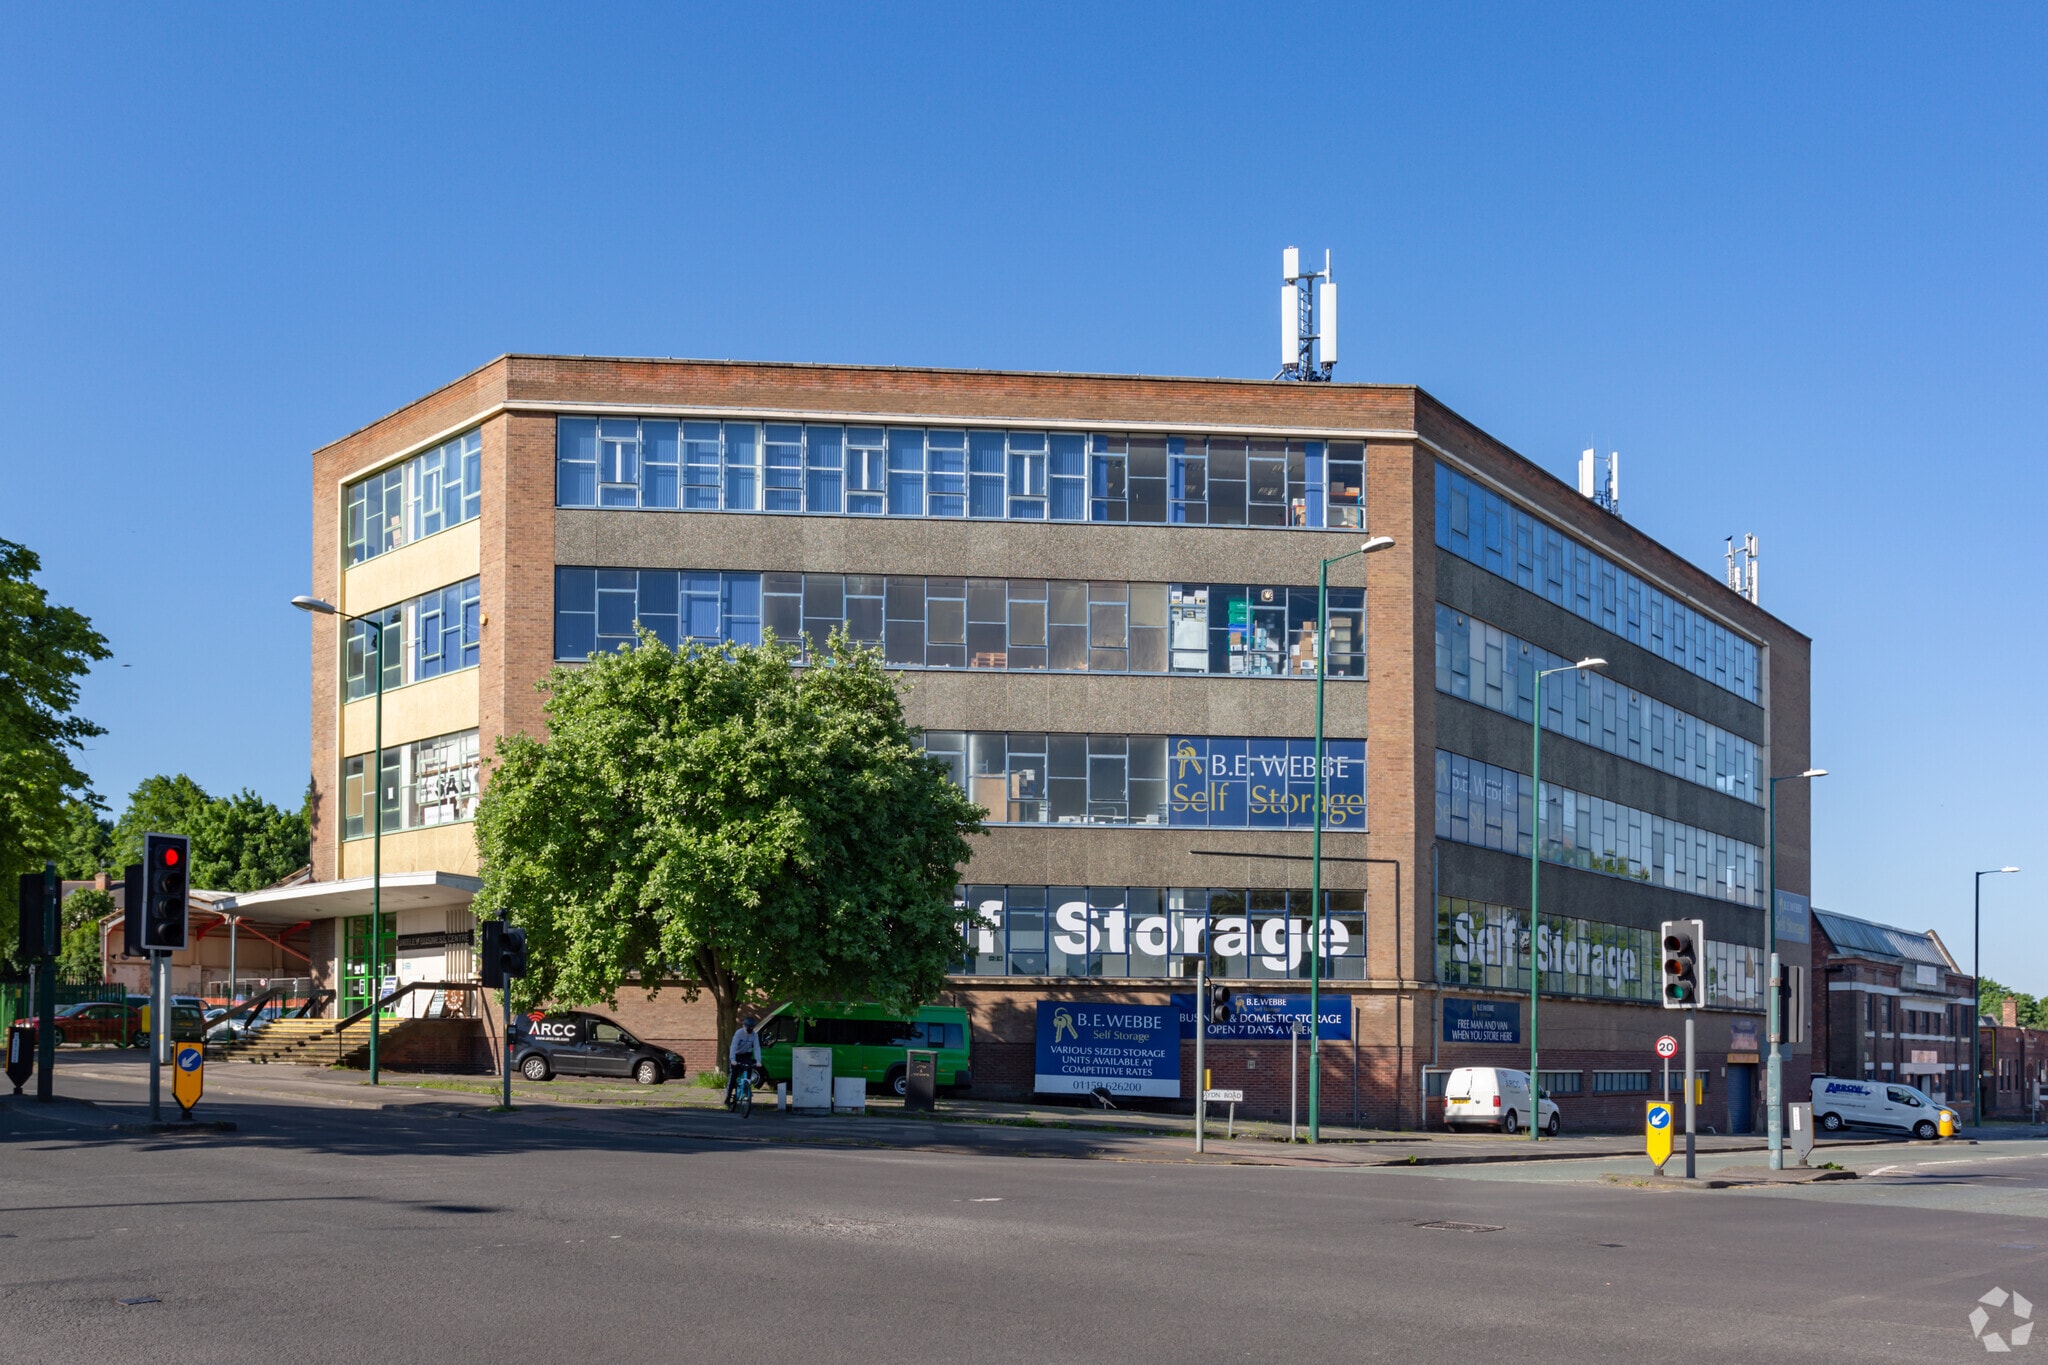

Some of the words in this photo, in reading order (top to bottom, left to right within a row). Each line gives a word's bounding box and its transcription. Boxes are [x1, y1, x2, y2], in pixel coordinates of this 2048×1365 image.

[1259, 755, 1349, 778] WEBBE
[1173, 782, 1229, 812] Self
[1251, 785, 1364, 825] Storage
[1054, 901, 1351, 972] Storage
[1454, 912, 1518, 967] Self
[1537, 925, 1636, 990] Storage
[1229, 1013, 1237, 1023] &
[1240, 1013, 1294, 1024] DOMESTIC
[528, 1021, 577, 1037] ARCC
[1207, 1025, 1236, 1034] OPEN
[1239, 1025, 1245, 1034] 7
[1247, 1025, 1274, 1034] DAYS
[1276, 1025, 1284, 1034] A
[1457, 1019, 1470, 1029] FREE
[1470, 1020, 1483, 1030] MAN
[1484, 1020, 1496, 1031] AND
[1497, 1021, 1508, 1031] VAN
[1093, 1030, 1111, 1040] Self
[1113, 1030, 1150, 1043] Storage
[1451, 1030, 1470, 1040] WHEN
[1470, 1031, 1482, 1041] YOU
[1483, 1031, 1499, 1041] STORE
[1500, 1032, 1513, 1041] HERE
[1050, 1045, 1093, 1055] VARIOUS
[1094, 1047, 1121, 1056] SIZED
[1123, 1048, 1166, 1058] STORAGE
[1659, 1043, 1674, 1052] 20
[1062, 1056, 1090, 1065] UNITS
[1092, 1057, 1140, 1067] AVAILABLE
[1141, 1059, 1153, 1067] AT
[1061, 1065, 1124, 1076] COMPETITIVE
[1126, 1067, 1153, 1077] RATES
[1072, 1080, 1103, 1090] 01159
[1105, 1082, 1142, 1091] 626200
[1825, 1082, 1865, 1094] ARROW
[1203, 1091, 1220, 1099] AYDN
[1223, 1091, 1242, 1099] ROAD
